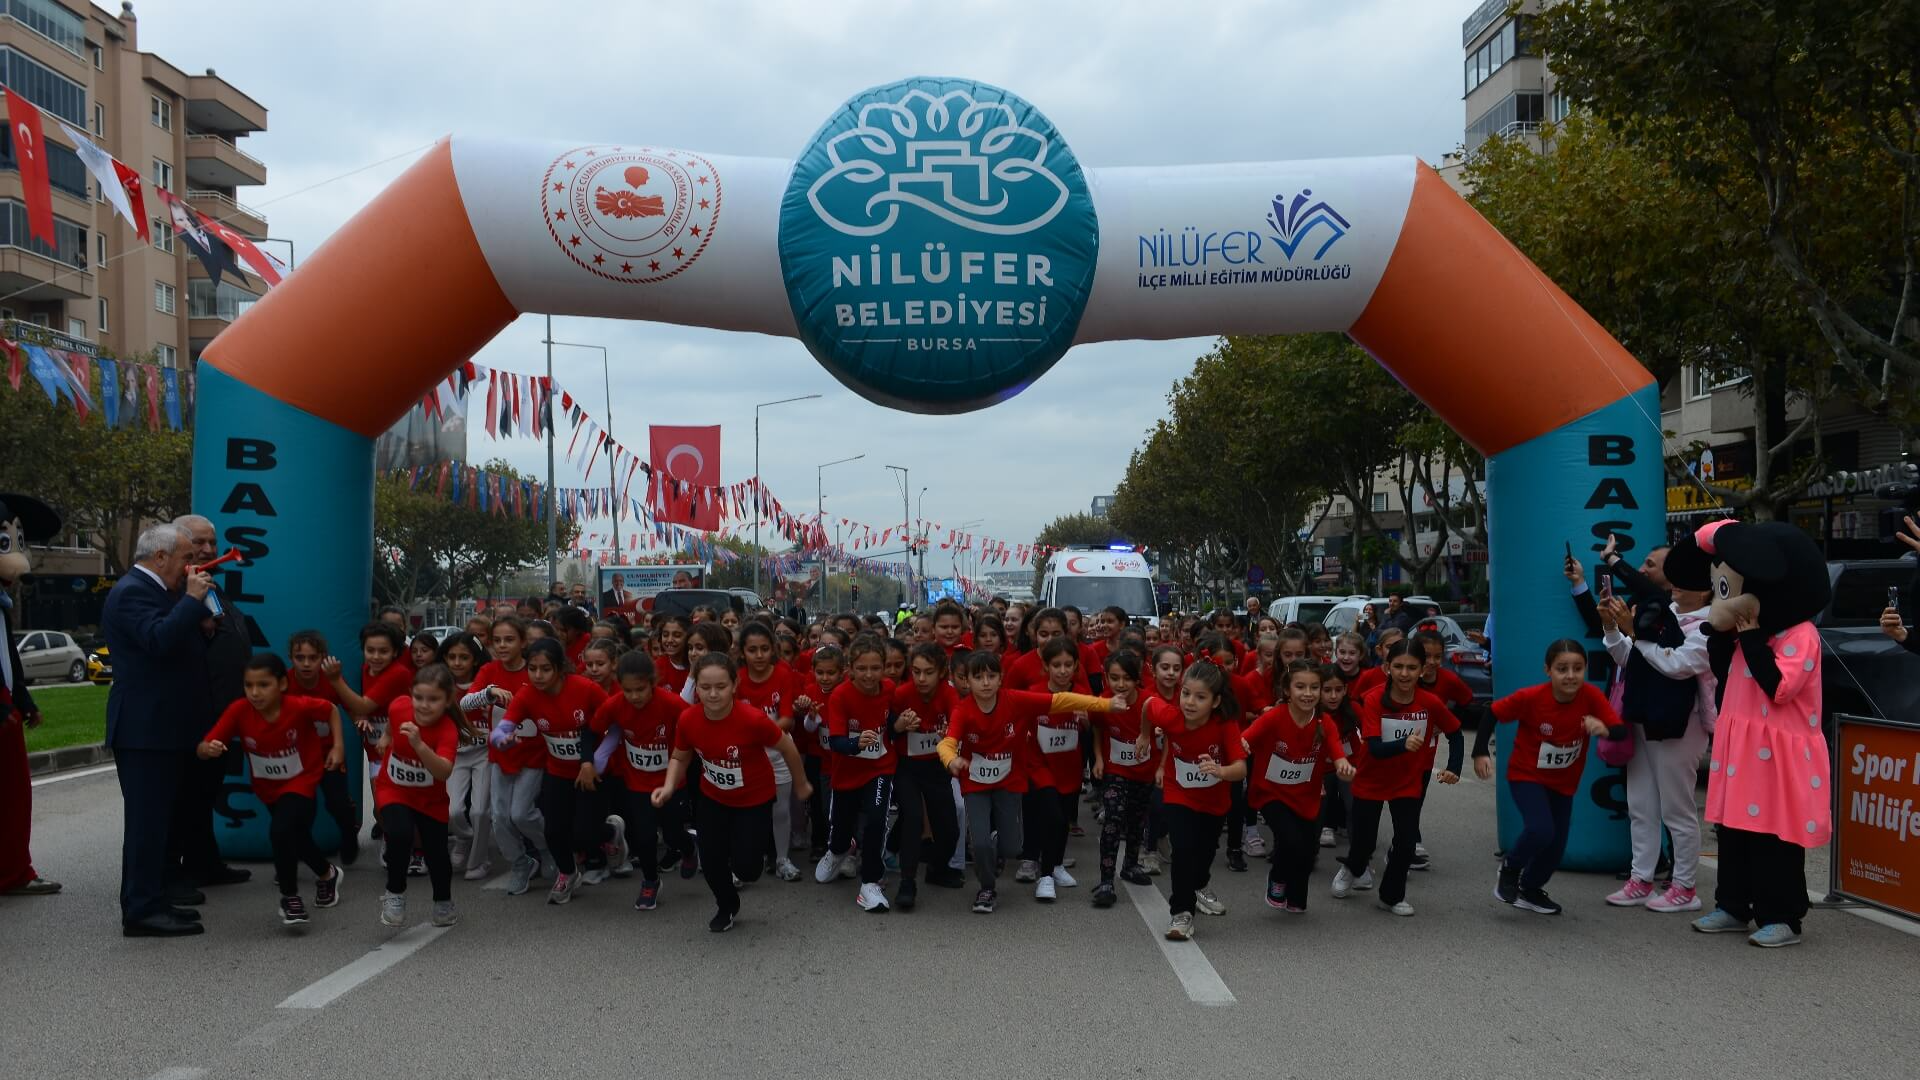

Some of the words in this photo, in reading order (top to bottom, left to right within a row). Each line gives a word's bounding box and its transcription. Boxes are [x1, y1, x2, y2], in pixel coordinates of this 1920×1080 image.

[1139, 226, 1265, 268] NİLÜFER
[832, 242, 1054, 289] NİLÜFER
[1138, 273, 1167, 290] İLÇE
[1170, 270, 1207, 287] MİLLİ
[1210, 268, 1257, 285] EĞİTİM
[1261, 264, 1352, 284] MÜDÜRLÜĞÜ
[834, 293, 1047, 327] BELEDİYESİ
[906, 338, 977, 351] BURSA
[1049, 736, 1066, 747] 123
[630, 751, 662, 766] 1570
[1851, 743, 1907, 786] Spor
[265, 764, 288, 775] 001
[390, 764, 426, 783] 1599
[979, 767, 1000, 777] 070
[1186, 772, 1209, 782] 042
[1280, 769, 1301, 779] 029
